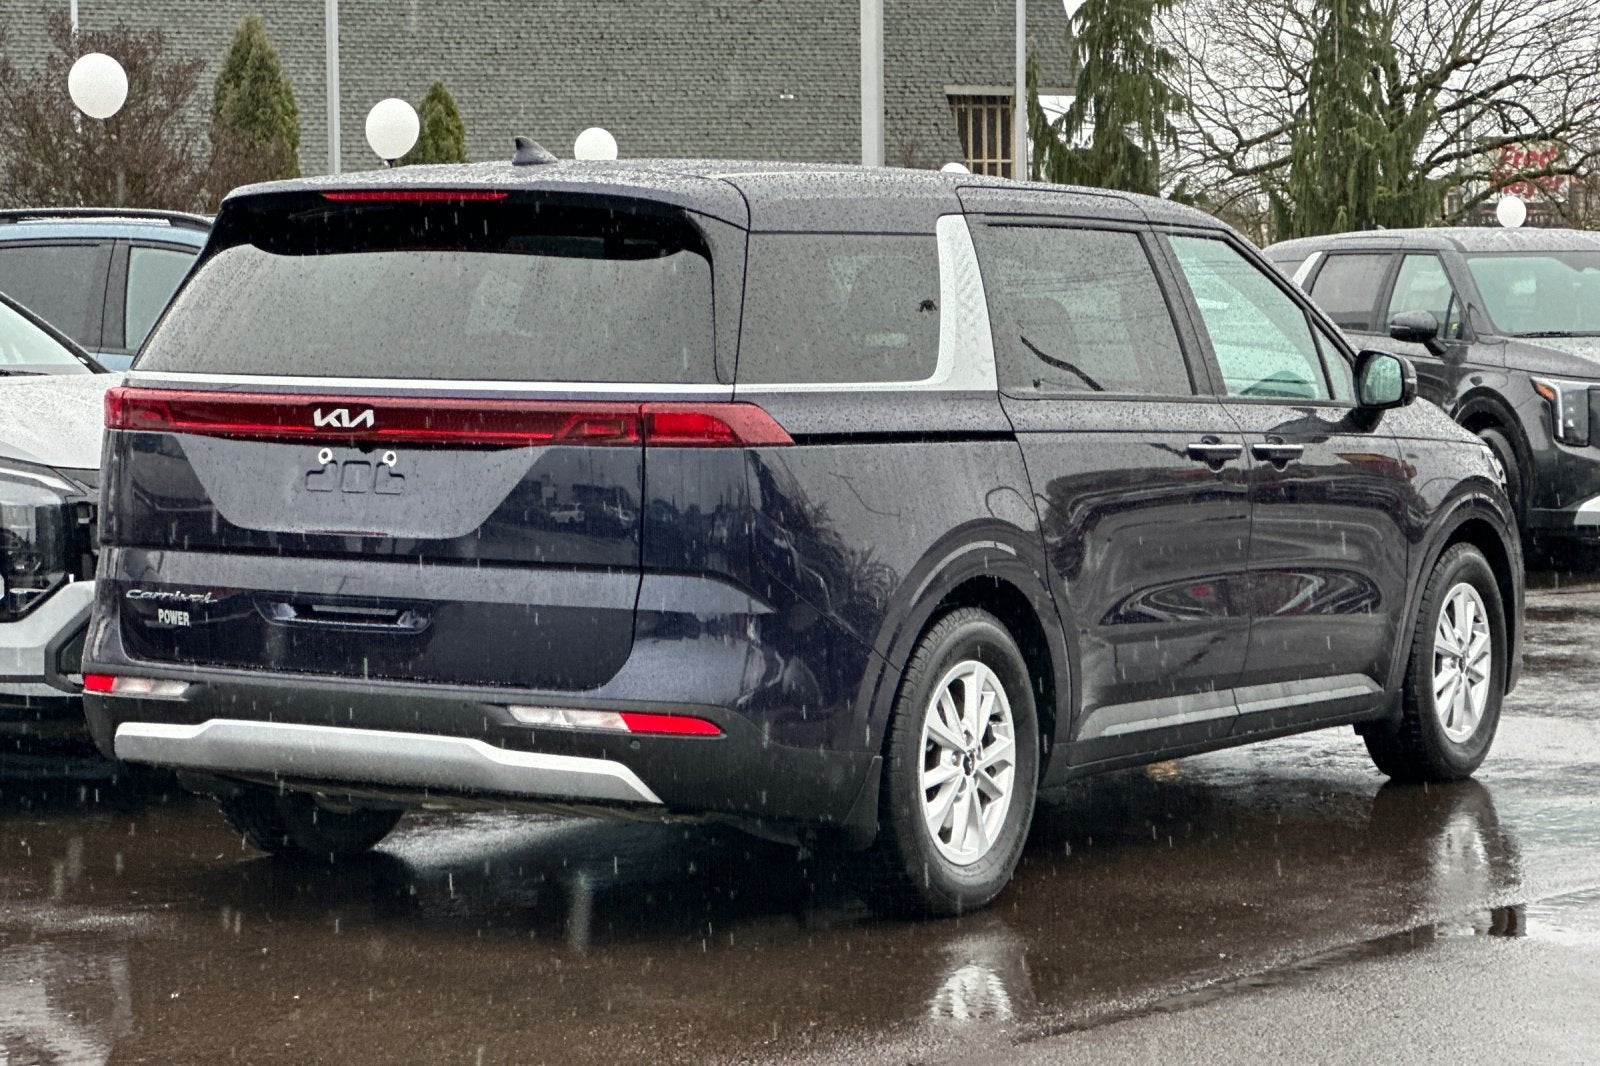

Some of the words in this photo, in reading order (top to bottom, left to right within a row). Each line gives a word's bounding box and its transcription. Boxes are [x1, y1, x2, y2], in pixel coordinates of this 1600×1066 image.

[313, 408, 375, 428] KIA
[126, 589, 218, 604] Carnival
[158, 608, 190, 626] POWER
